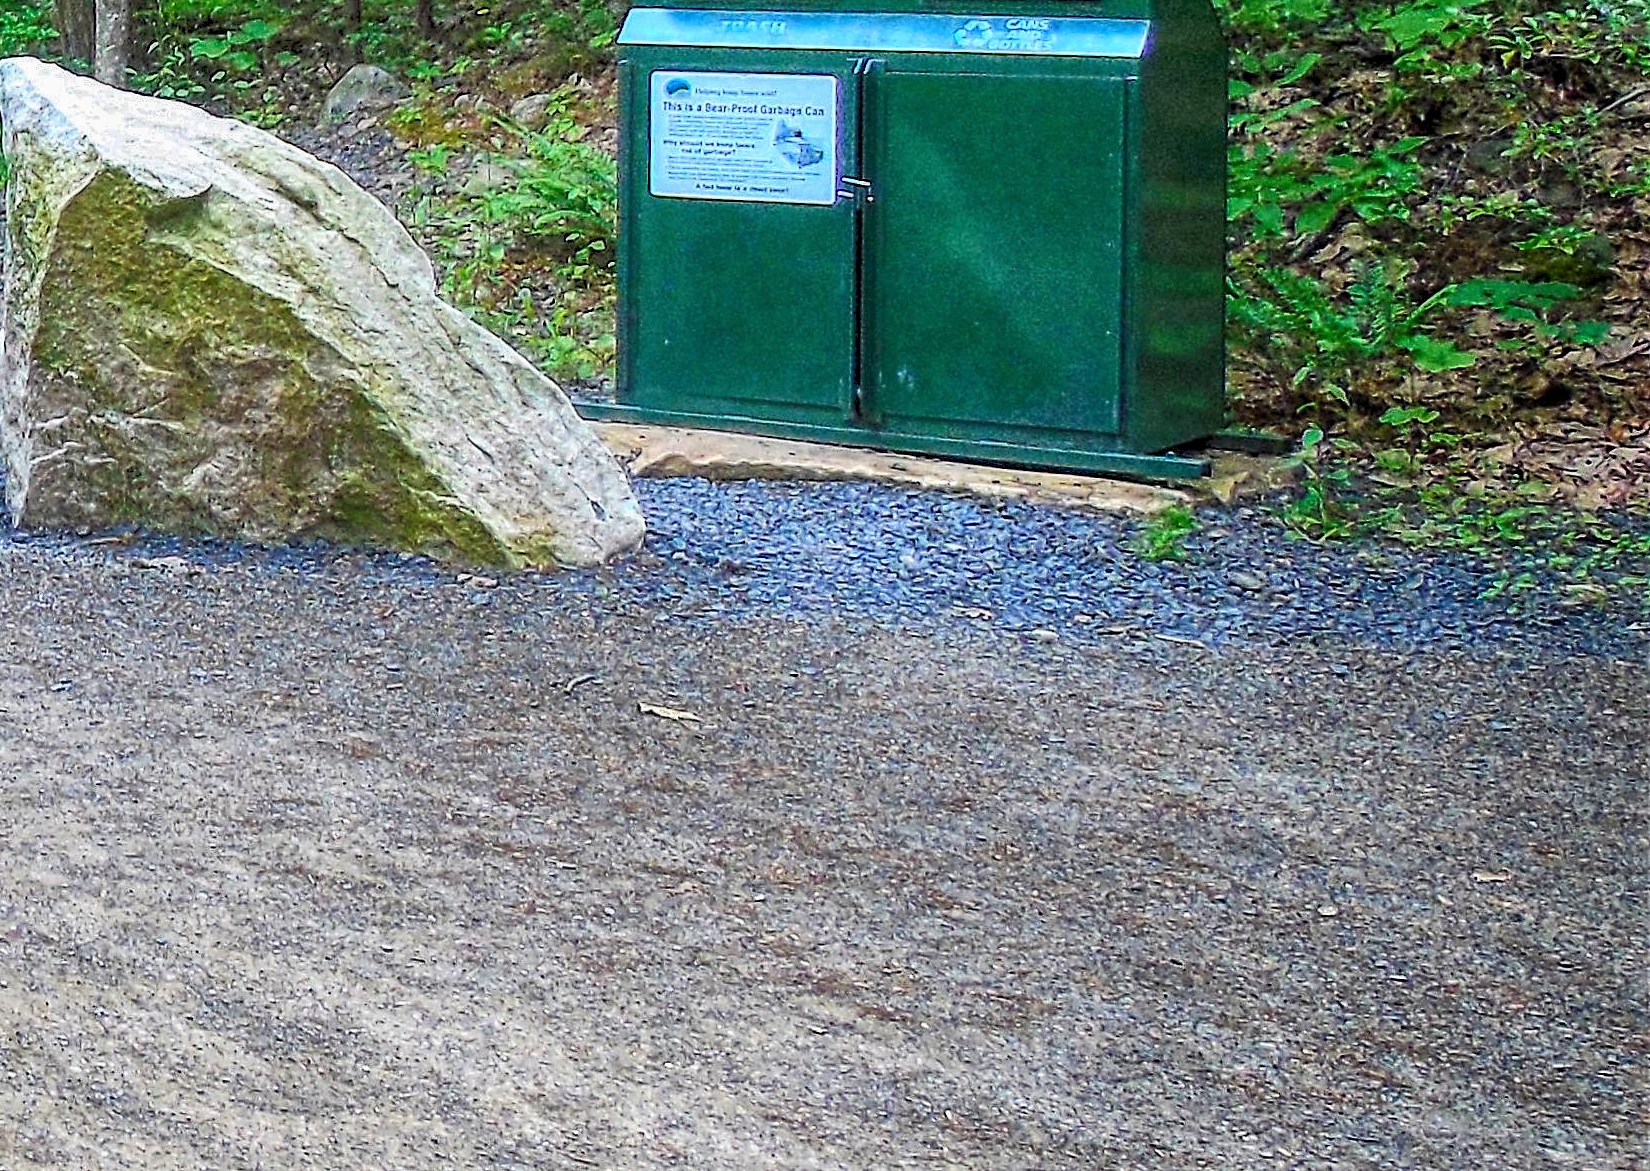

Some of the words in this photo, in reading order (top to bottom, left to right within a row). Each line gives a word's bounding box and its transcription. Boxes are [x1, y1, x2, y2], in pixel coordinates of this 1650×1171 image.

[1005, 18, 1049, 31] CANS
[663, 101, 682, 112] This
[684, 103, 693, 112] is
[696, 104, 702, 112] a
[705, 103, 757, 114] Bear-Proof
[761, 105, 802, 117] Garbage
[805, 106, 825, 116] Can
